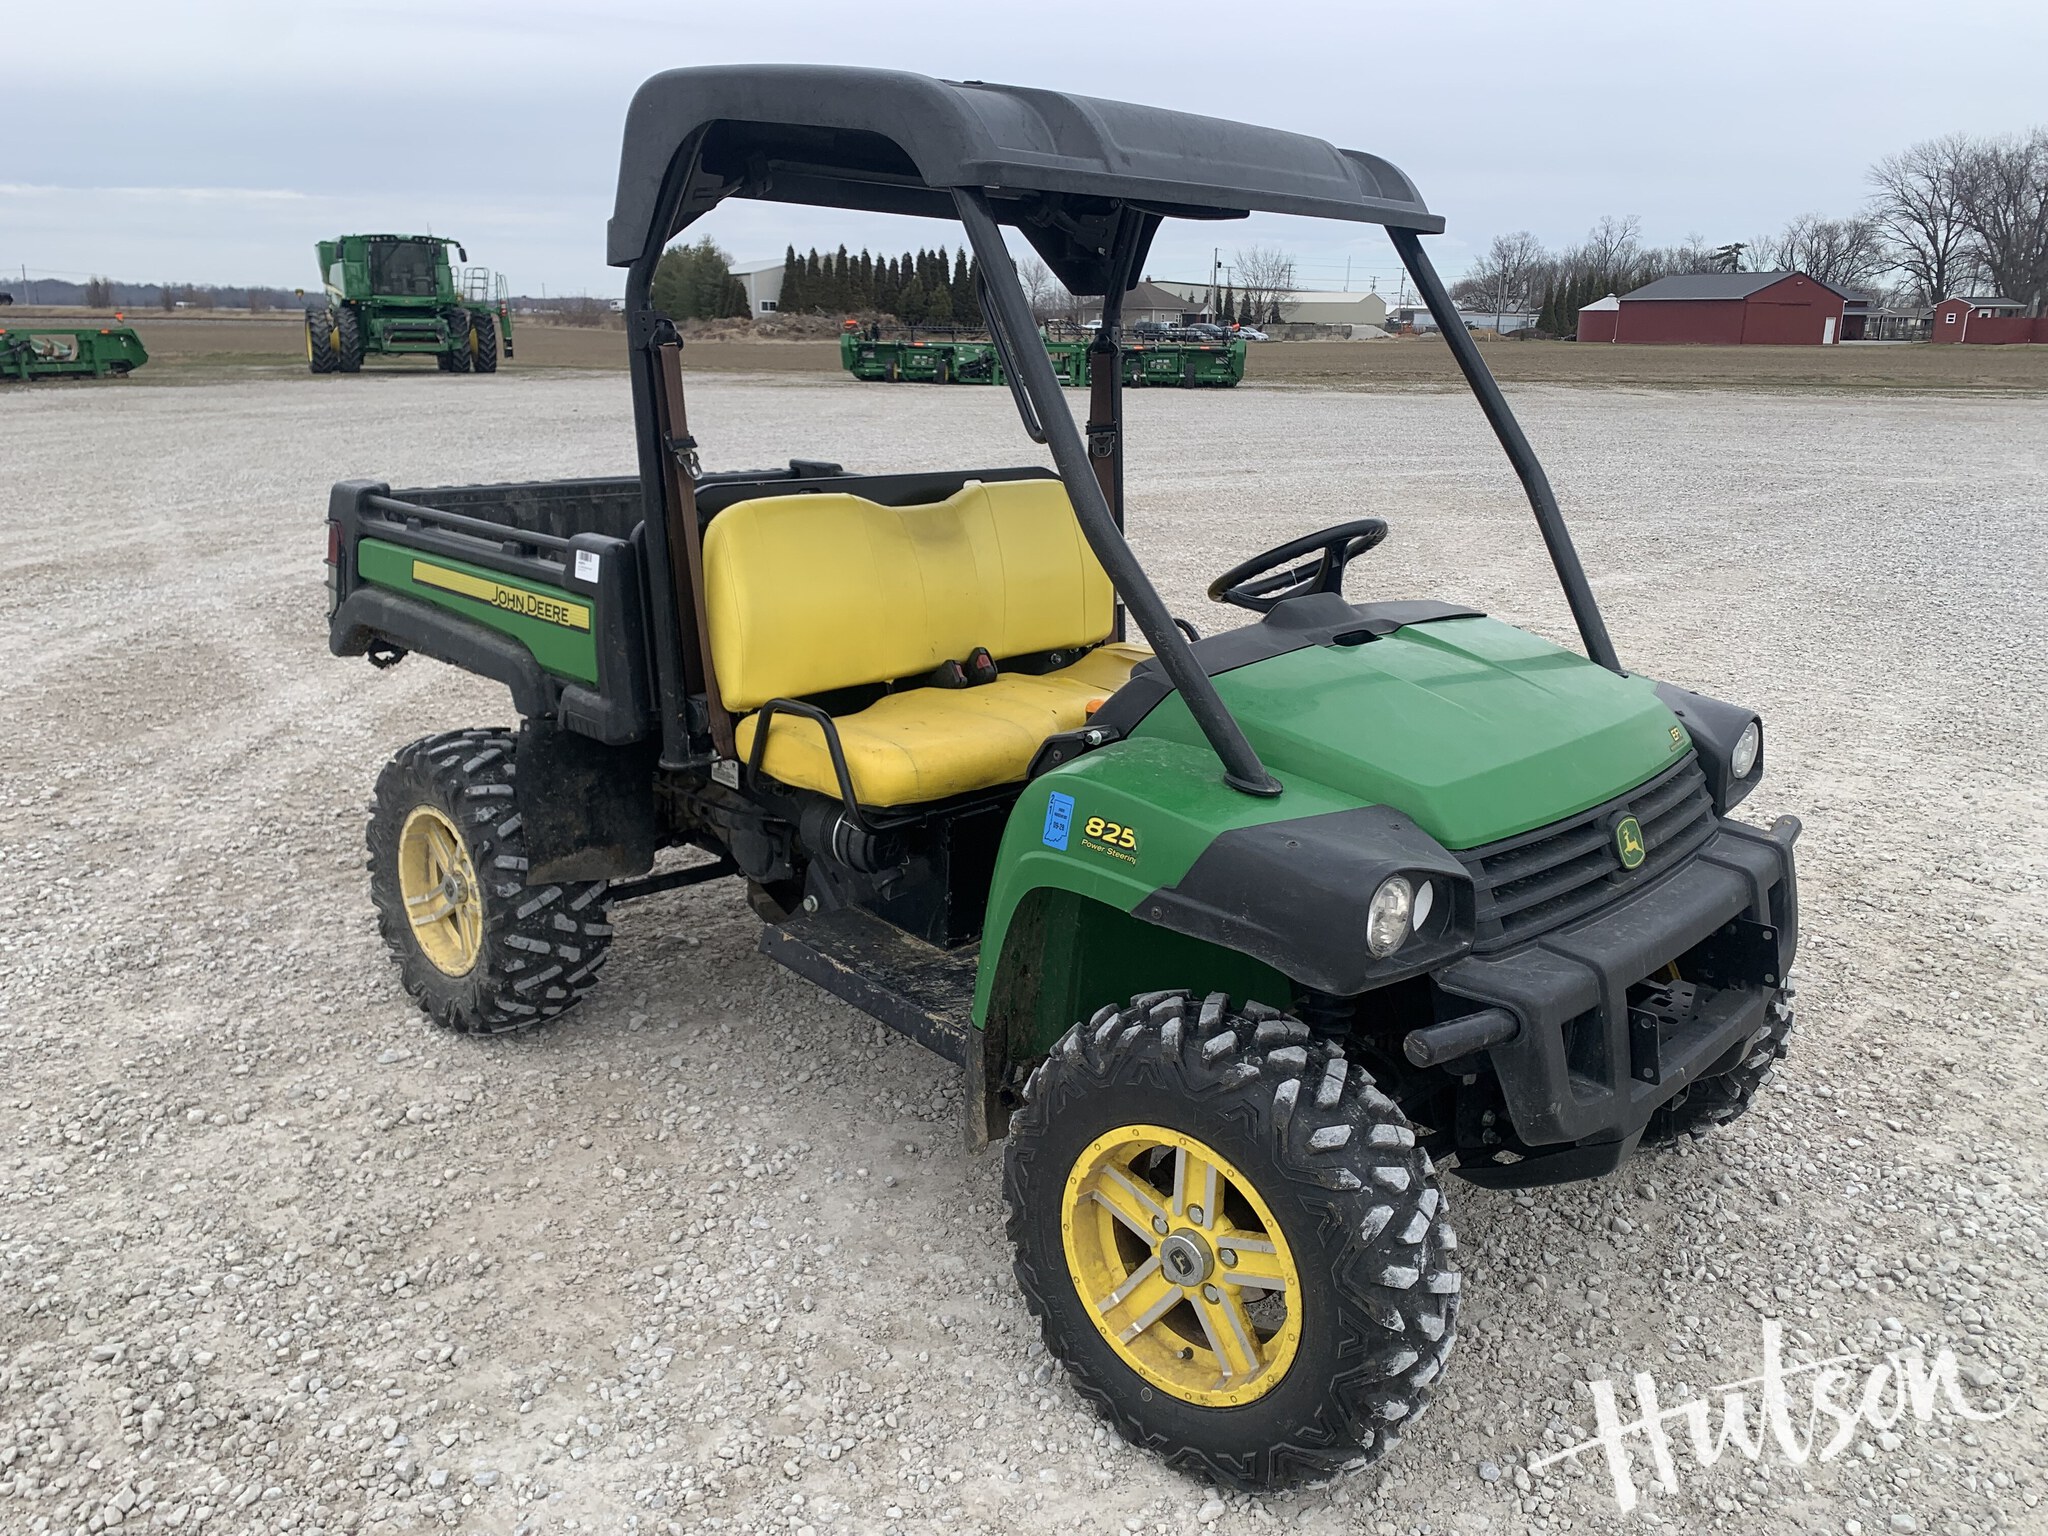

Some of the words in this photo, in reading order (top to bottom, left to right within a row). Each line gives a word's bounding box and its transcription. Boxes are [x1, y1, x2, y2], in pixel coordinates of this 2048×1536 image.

[491, 585, 525, 611] JOHN
[527, 595, 569, 623] DEERE
[1081, 838, 1106, 853] Power
[1084, 815, 1136, 850] 825
